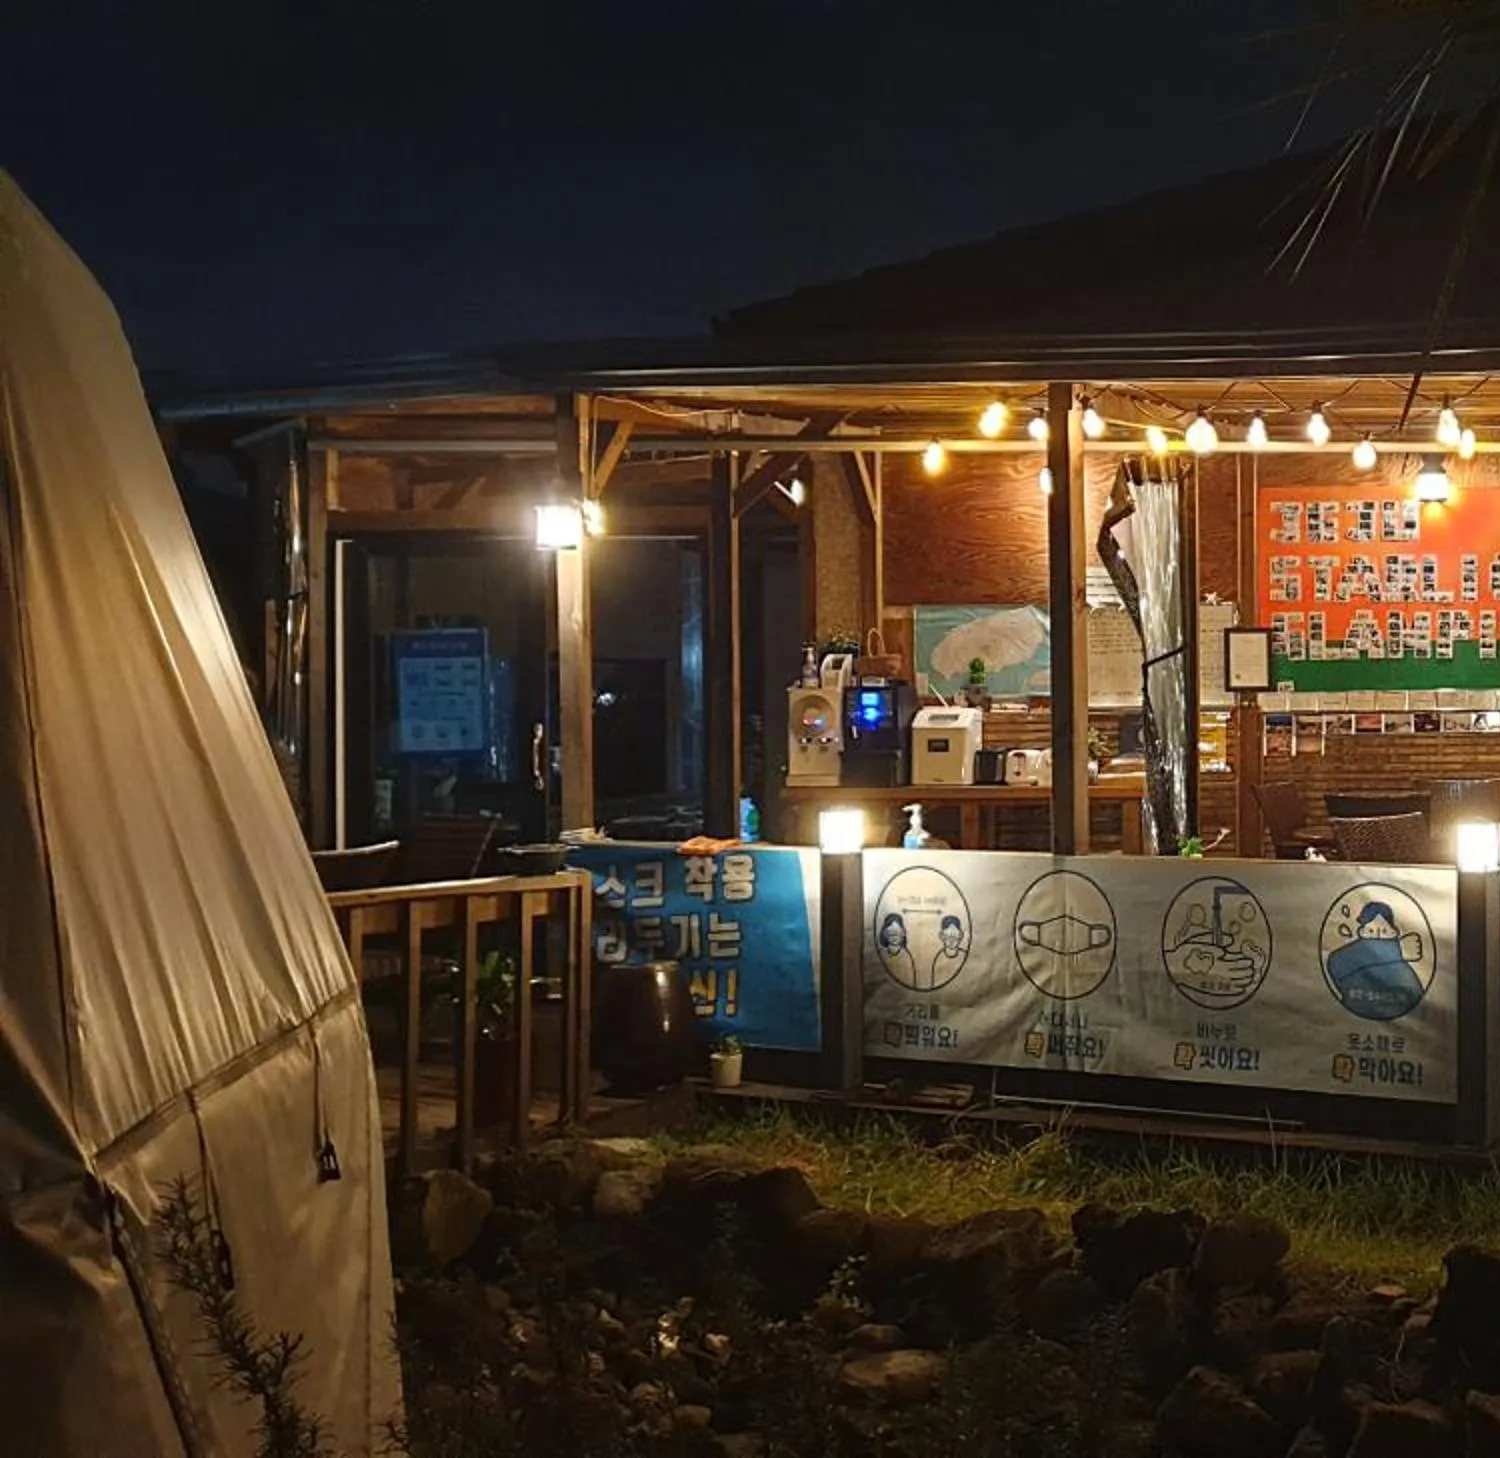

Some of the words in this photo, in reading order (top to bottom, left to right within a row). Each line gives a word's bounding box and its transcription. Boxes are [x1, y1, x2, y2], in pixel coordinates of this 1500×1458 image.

[1268, 501, 1421, 543] JEJU
[684, 854, 755, 903] 착용
[1358, 1056, 1424, 1087] 막아요!
